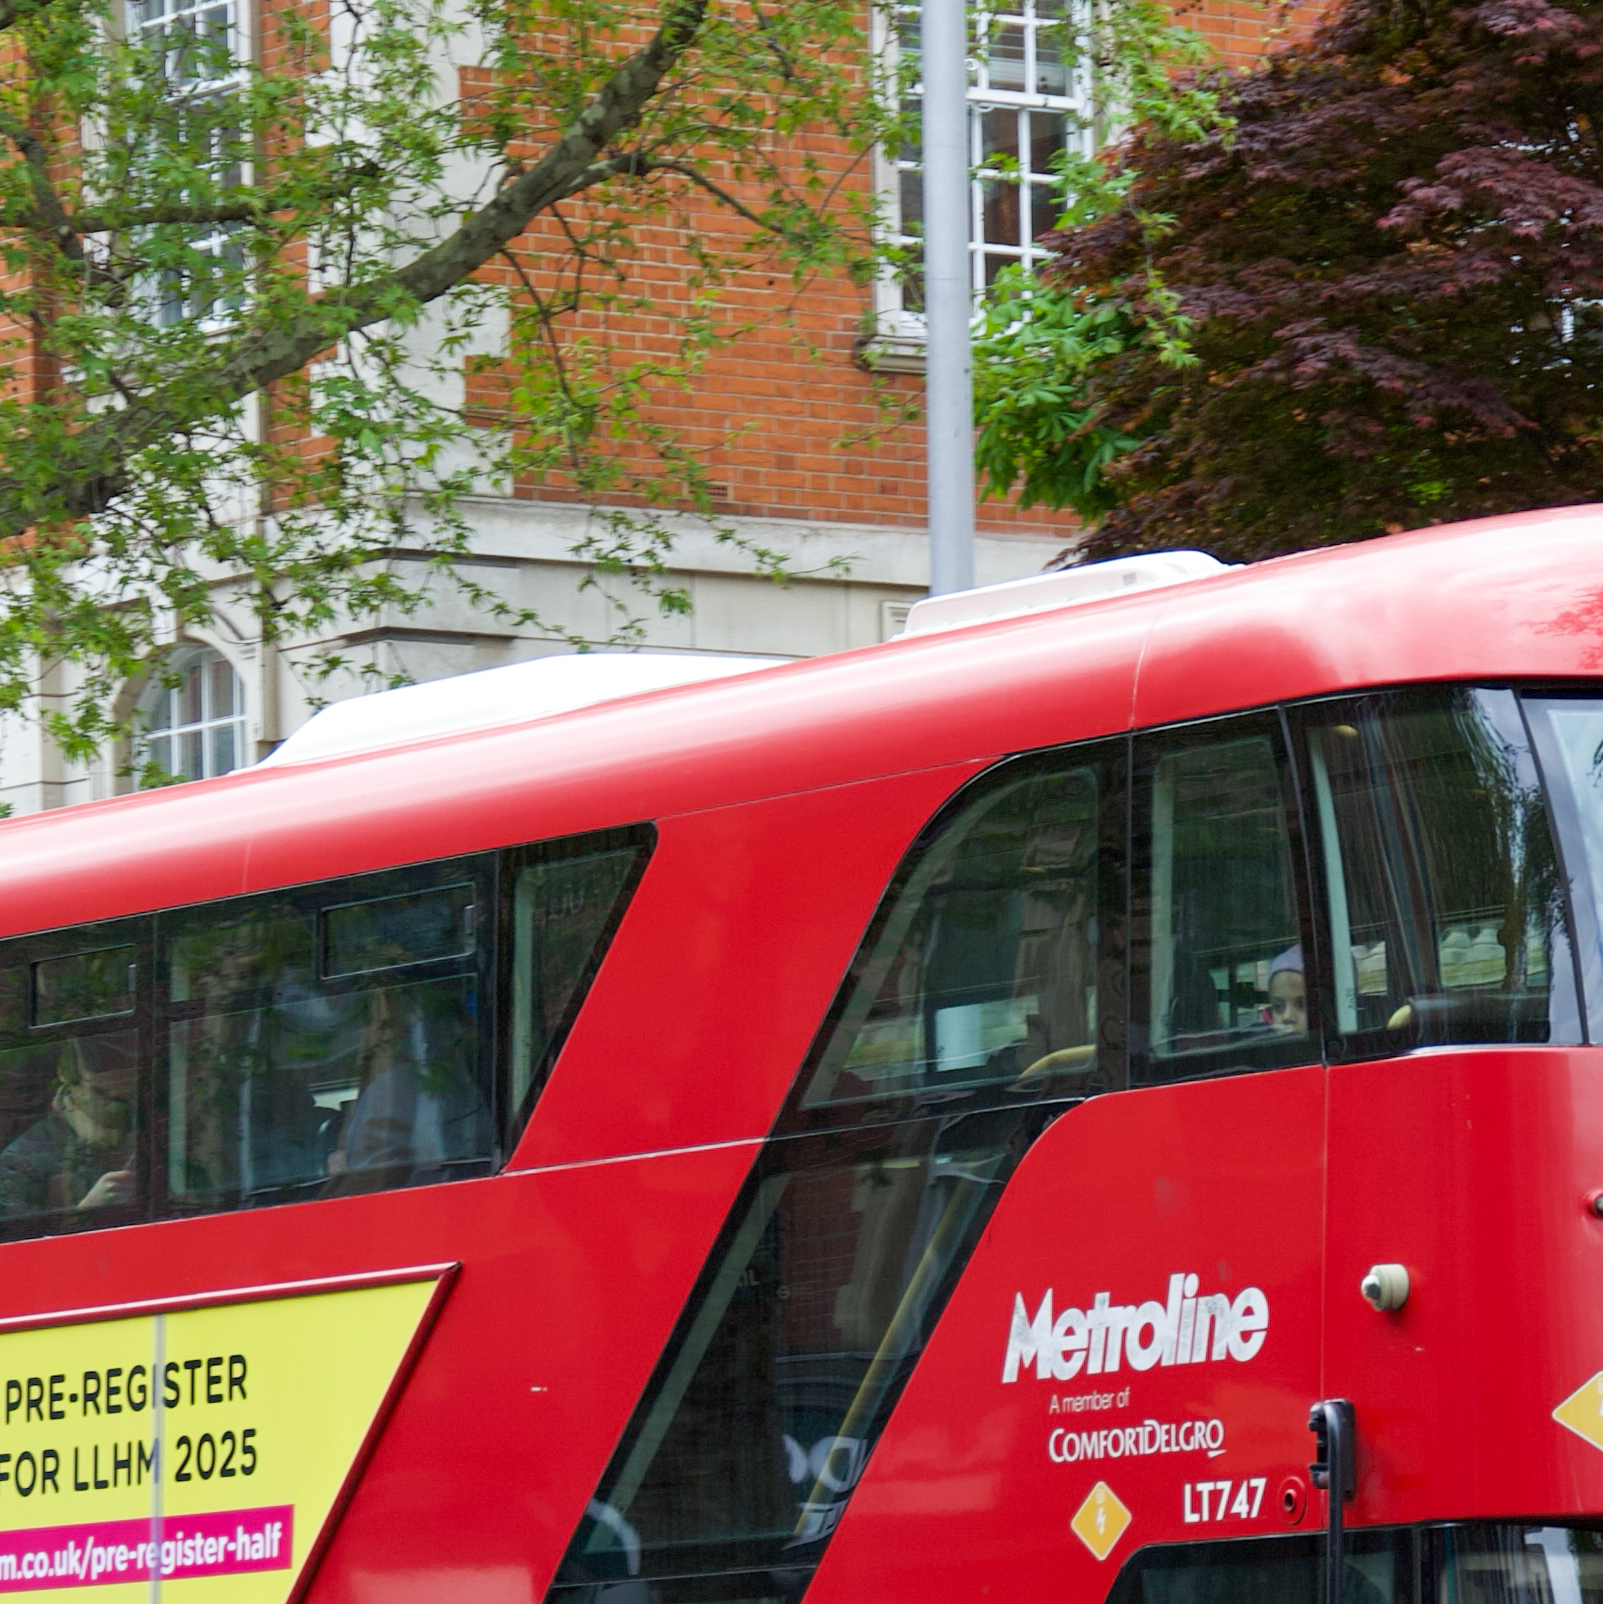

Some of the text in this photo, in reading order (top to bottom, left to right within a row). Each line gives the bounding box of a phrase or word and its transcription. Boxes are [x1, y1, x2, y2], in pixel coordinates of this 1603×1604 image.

[1002, 1273, 1269, 1383] Metroline
[6, 1354, 248, 1425] PRE-REGISTER
[1049, 1387, 1130, 1414] A member of
[74, 1437, 160, 1492] LLHM
[175, 1428, 258, 1483] 2025
[1184, 1478, 1267, 1523] LT747
